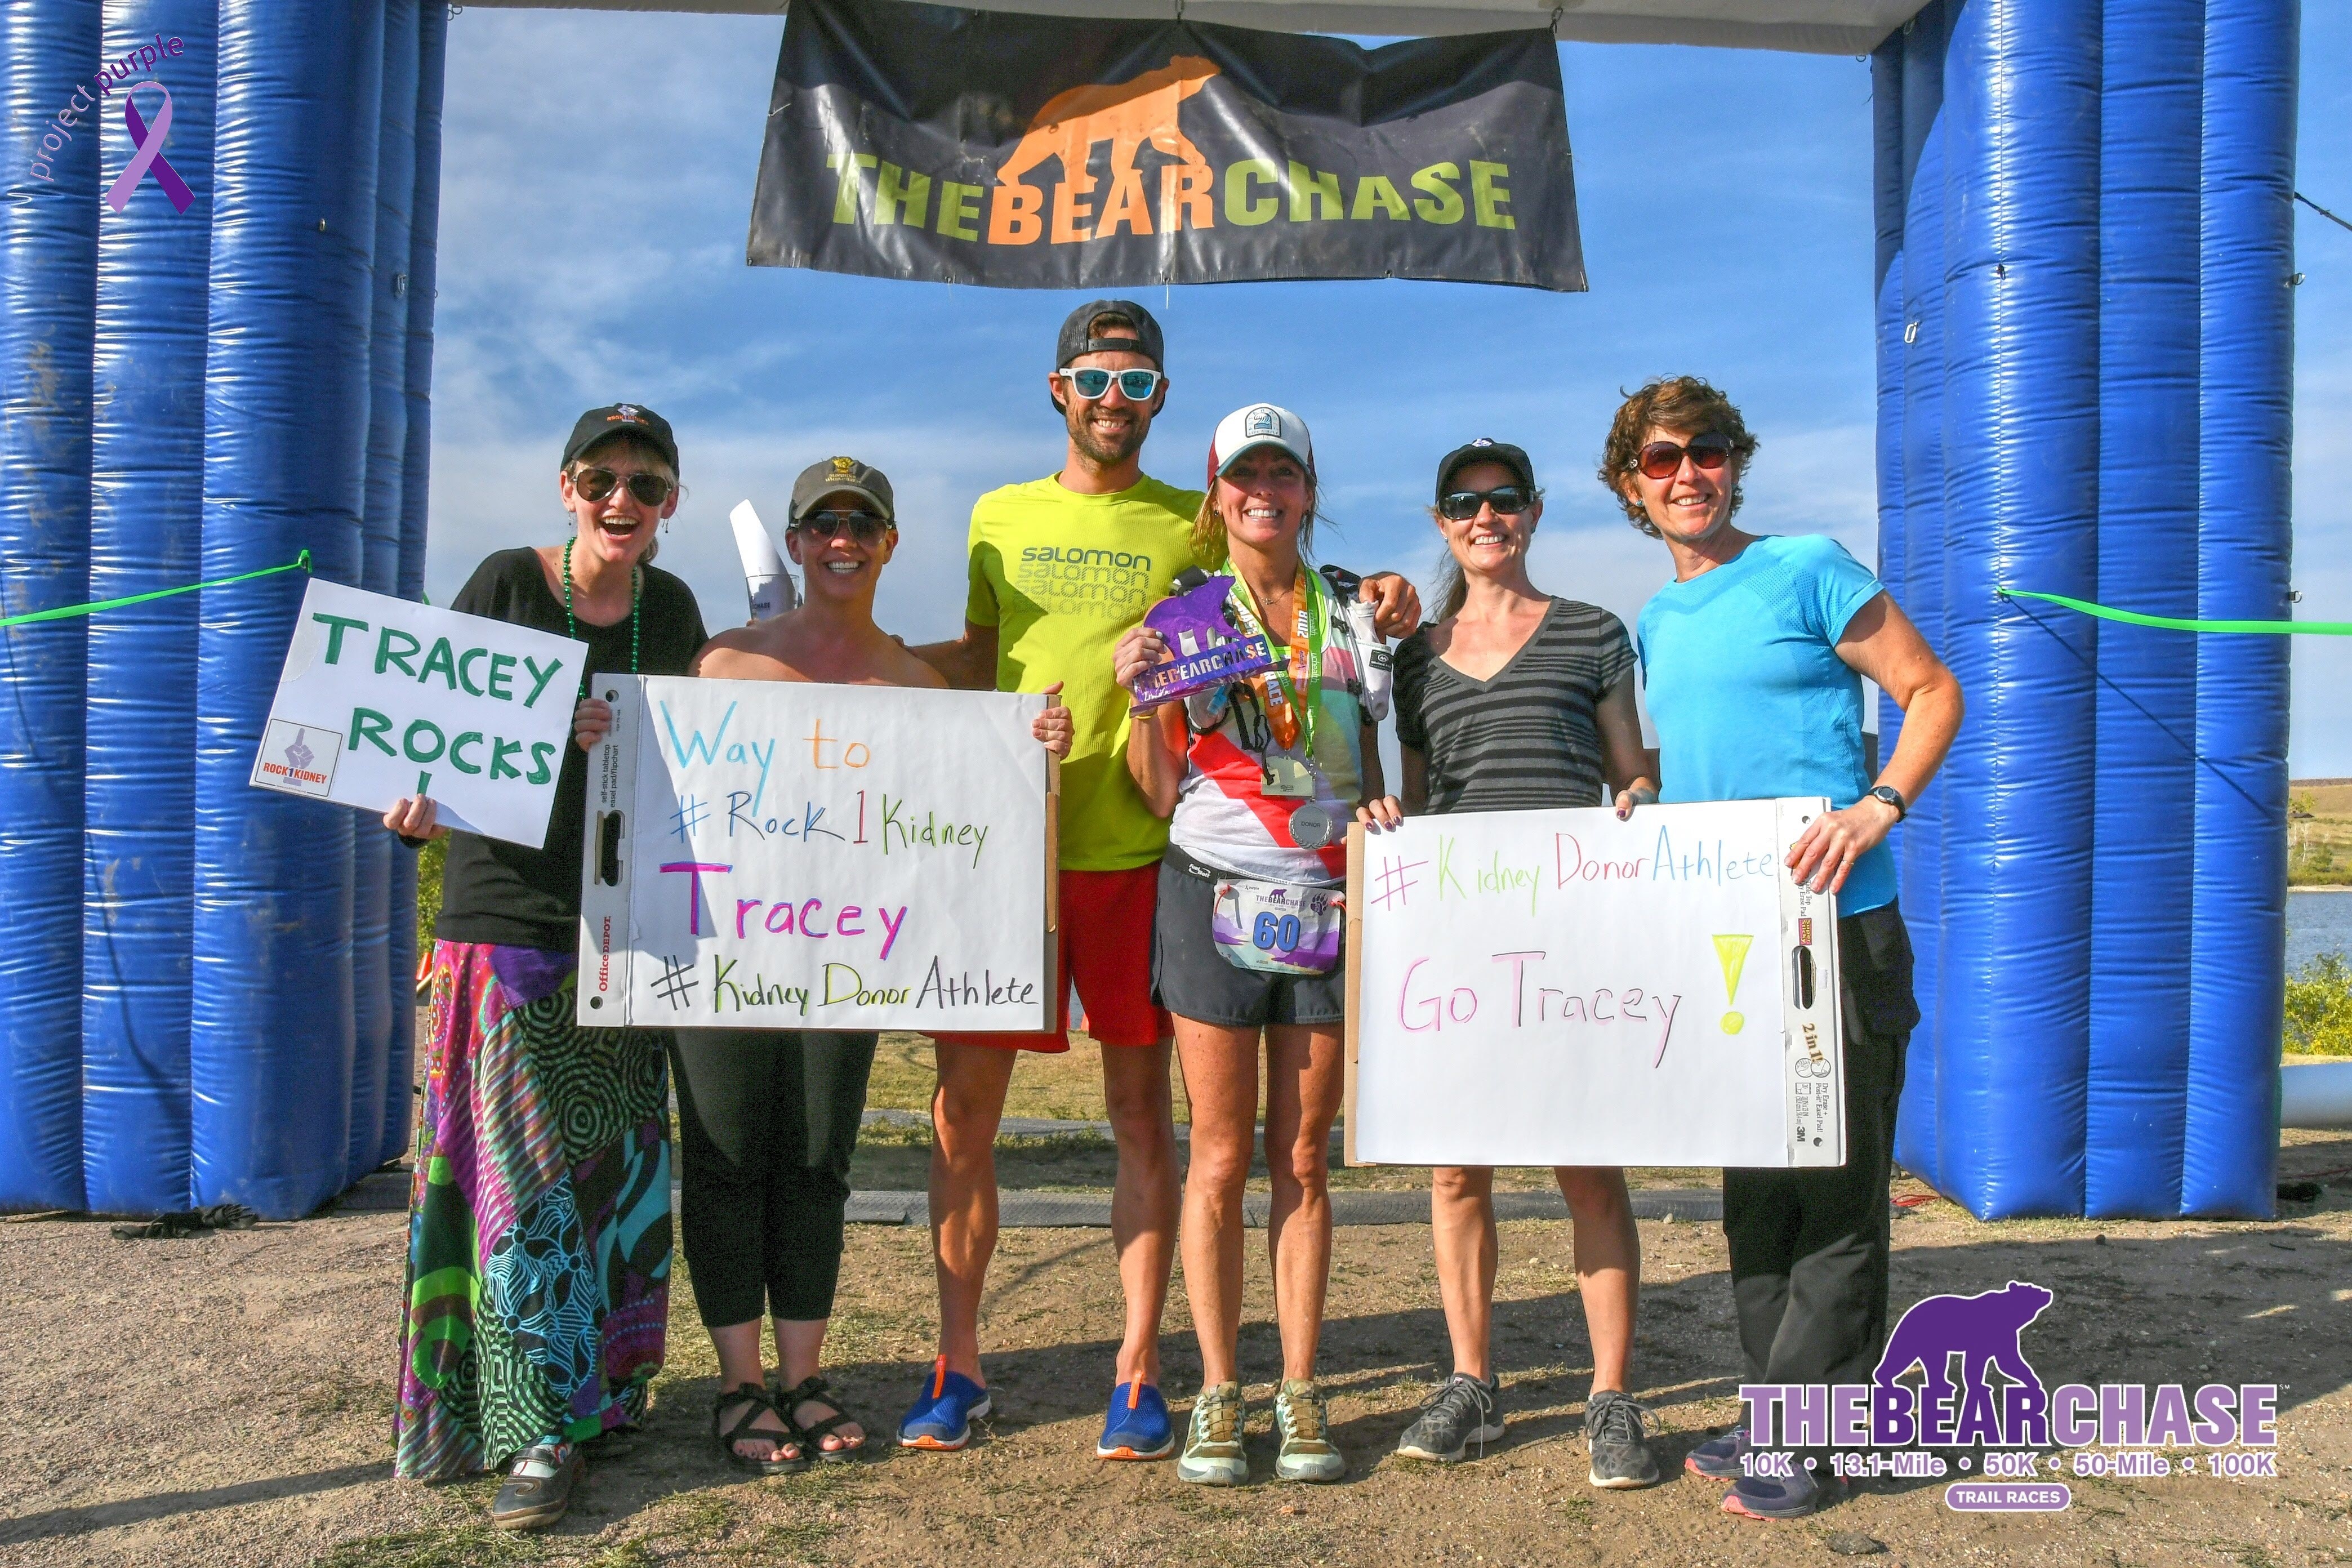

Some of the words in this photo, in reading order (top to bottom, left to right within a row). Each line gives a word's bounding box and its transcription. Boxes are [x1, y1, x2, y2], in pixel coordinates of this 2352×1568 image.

[1021, 547, 1151, 571] salomon
[1297, 610, 1308, 639] 2018
[313, 612, 564, 708] TRACEY
[347, 706, 556, 786] ROCKS
[603, 744, 611, 772] tabletop
[660, 700, 775, 817] Way
[804, 718, 871, 770] to
[611, 745, 619, 789] pad/flipchart
[1188, 863, 1201, 872] Fuel
[1198, 870, 1211, 879] Belt
[659, 861, 908, 961] Tracey
[1252, 911, 1301, 953] 60
[599, 954, 609, 992] Office
[1398, 956, 1478, 1035] Go
[1491, 951, 1682, 1069] Tracey
[1802, 1023, 1815, 1033] 2
[1806, 1035, 1818, 1049] in
[1796, 1126, 1806, 1142] 3M
